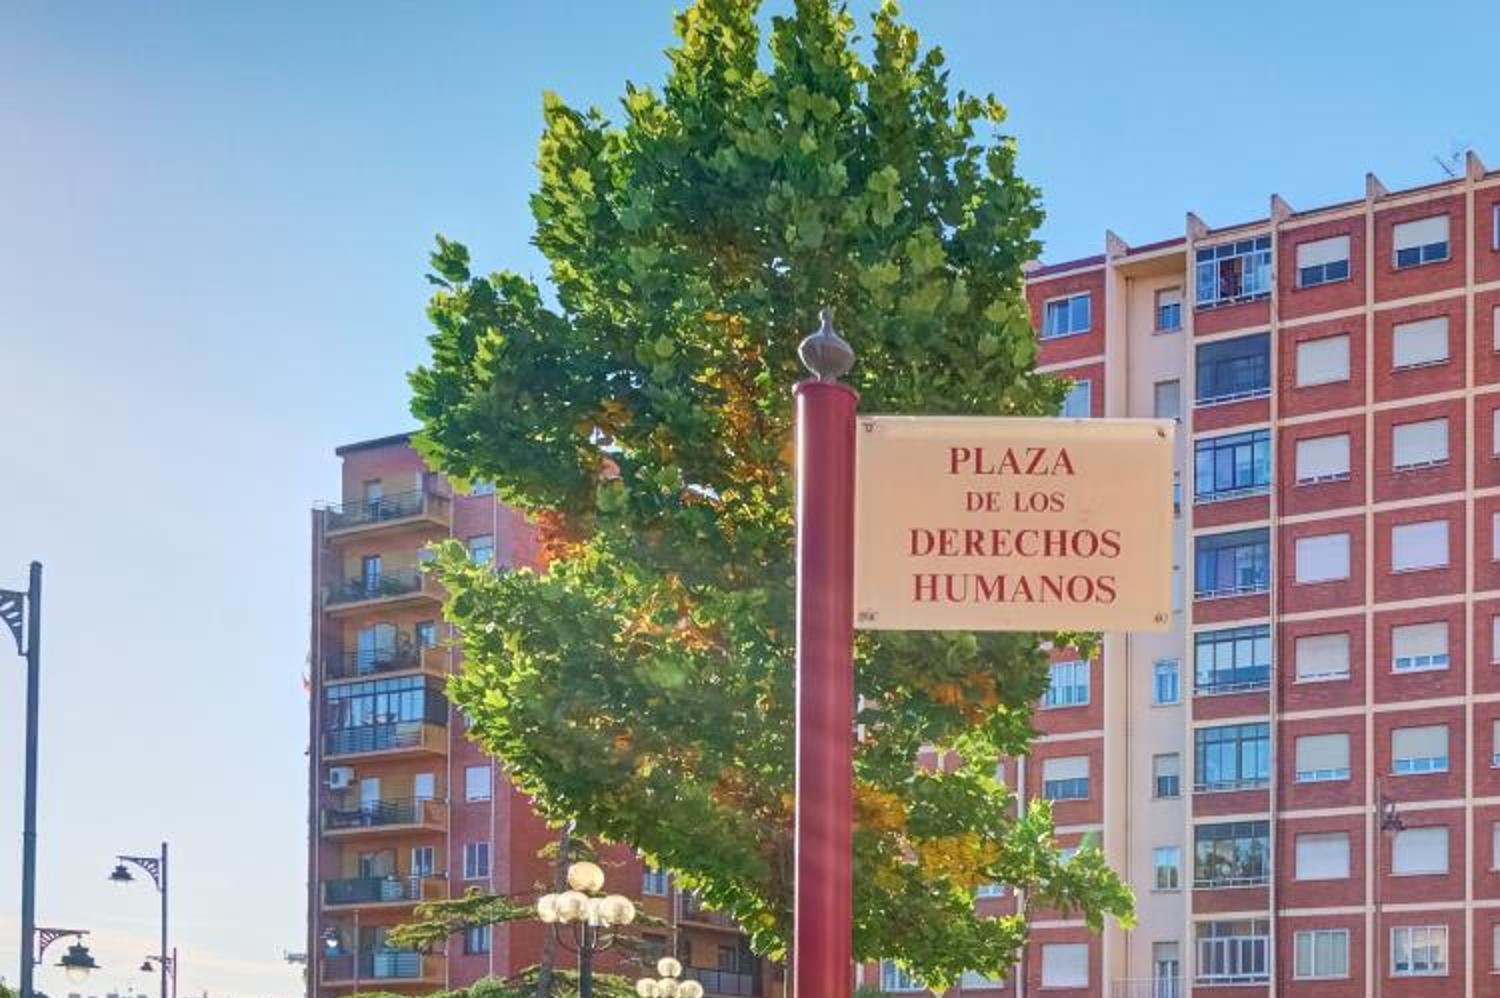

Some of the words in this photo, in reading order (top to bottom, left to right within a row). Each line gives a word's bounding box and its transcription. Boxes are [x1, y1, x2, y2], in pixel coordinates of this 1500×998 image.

[949, 447, 1075, 475] PLAZA
[966, 491, 1001, 512] DE
[1014, 491, 1065, 513] LOS
[909, 528, 1121, 558] DERECHOS
[912, 573, 1118, 604] HUMANOS
